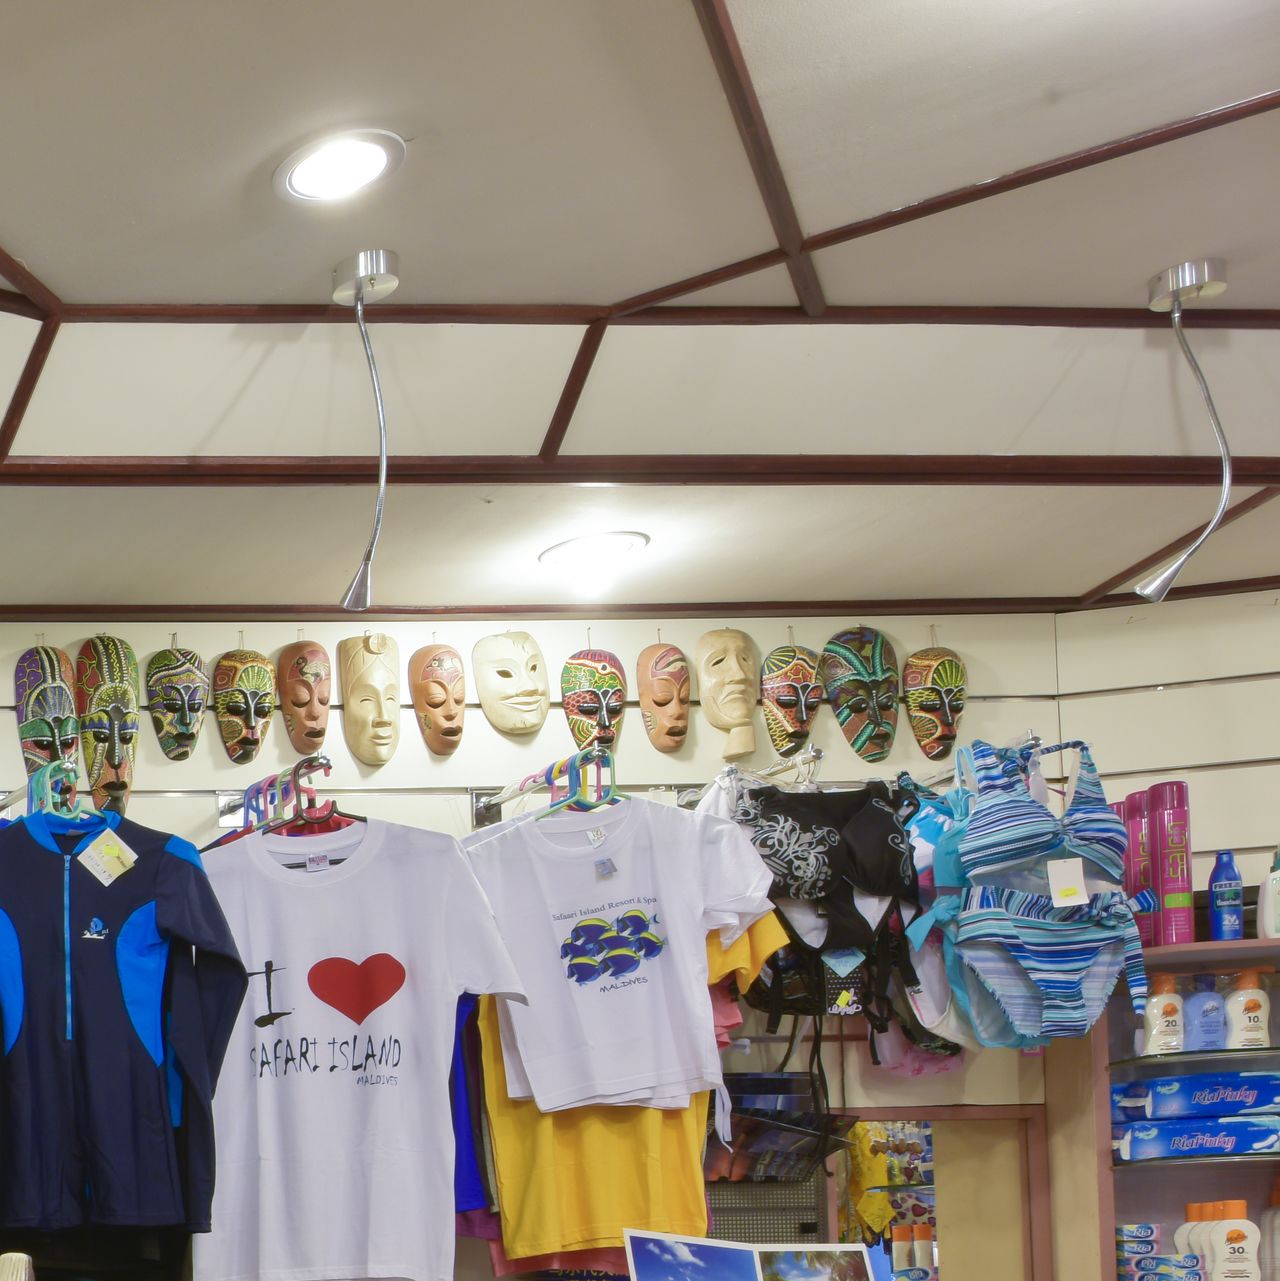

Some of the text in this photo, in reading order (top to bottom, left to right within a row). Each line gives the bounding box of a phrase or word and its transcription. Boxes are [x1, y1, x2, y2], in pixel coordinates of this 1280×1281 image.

[579, 905, 605, 916] Island
[608, 898, 636, 910] Resort
[643, 896, 657, 906] Spa
[599, 976, 649, 993] MALDIVES
[247, 960, 293, 1028] I
[1164, 1019, 1178, 1028] 20
[1247, 1016, 1260, 1024] 10
[327, 1035, 401, 1072] ISLAND
[356, 1074, 399, 1086] MALDIVES
[1228, 1246, 1245, 1255] 30
